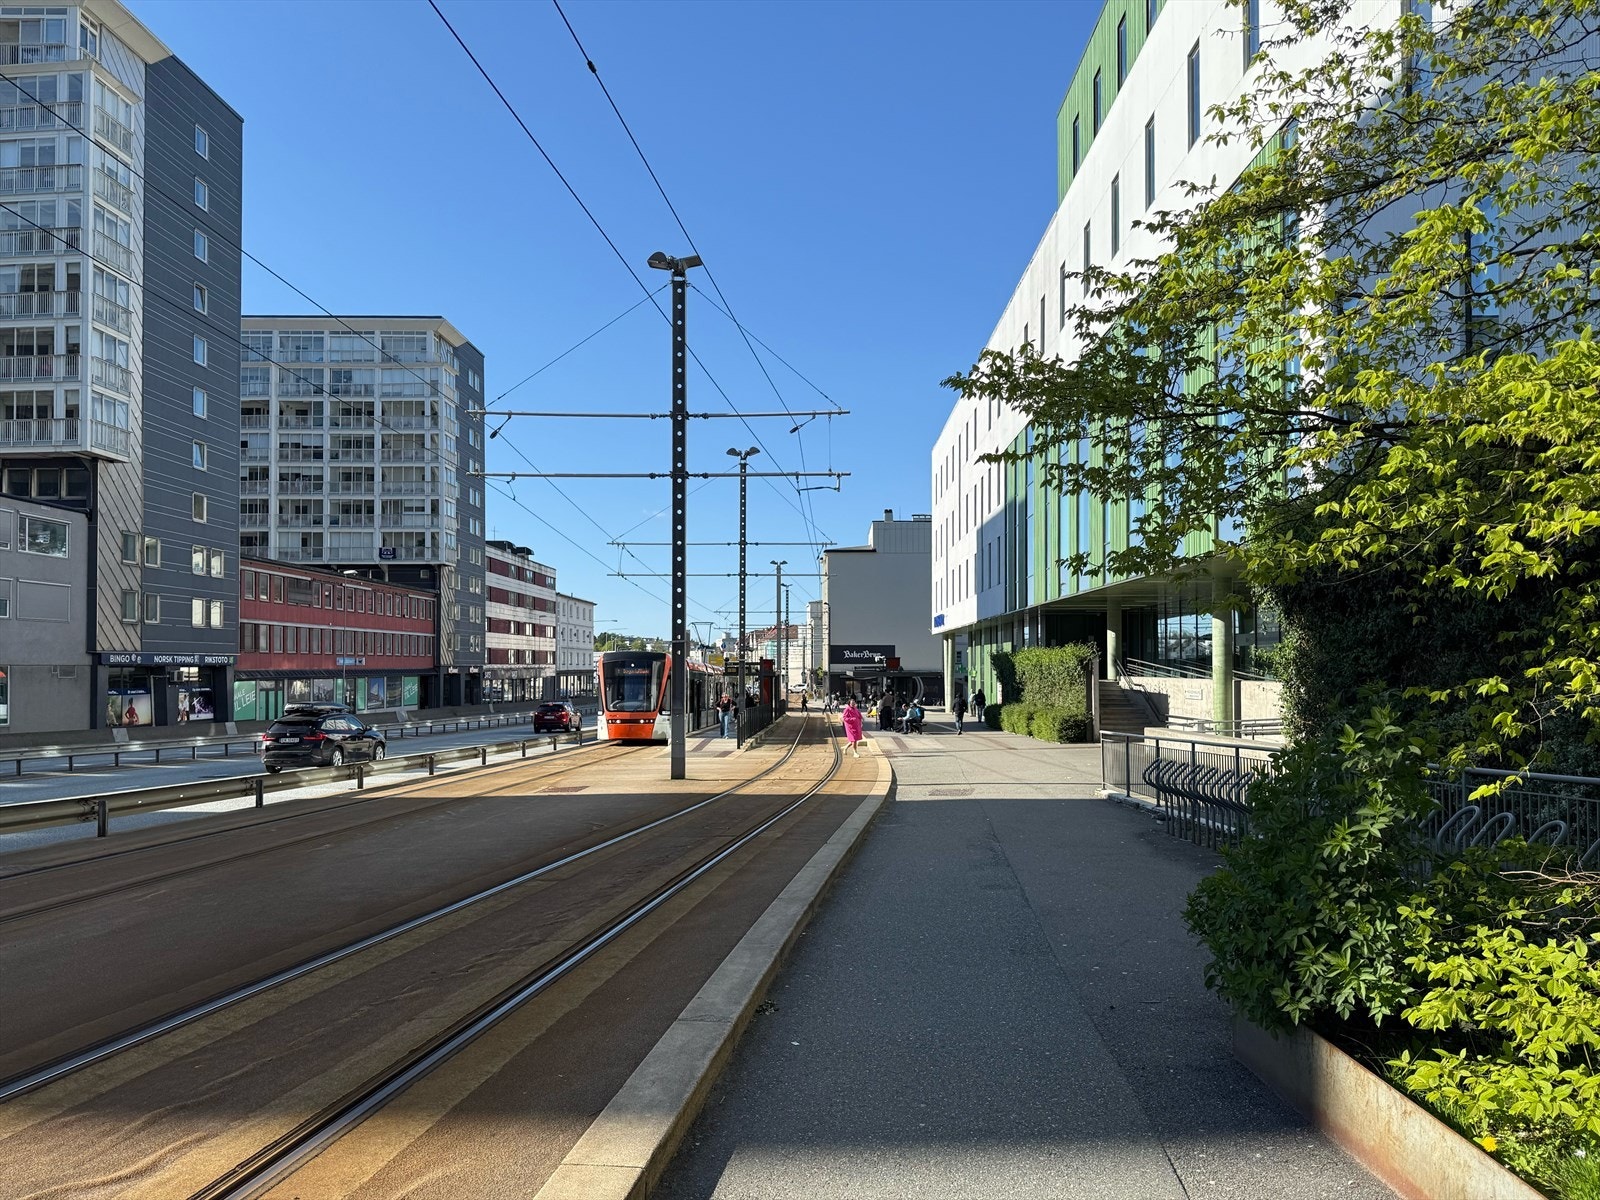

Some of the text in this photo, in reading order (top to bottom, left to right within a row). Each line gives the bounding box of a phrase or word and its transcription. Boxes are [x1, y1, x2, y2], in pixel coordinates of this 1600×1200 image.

[110, 654, 130, 663] BINGO
[153, 655, 194, 663] NORSK TIPPING
[204, 656, 228, 664] RIKSTOTO
